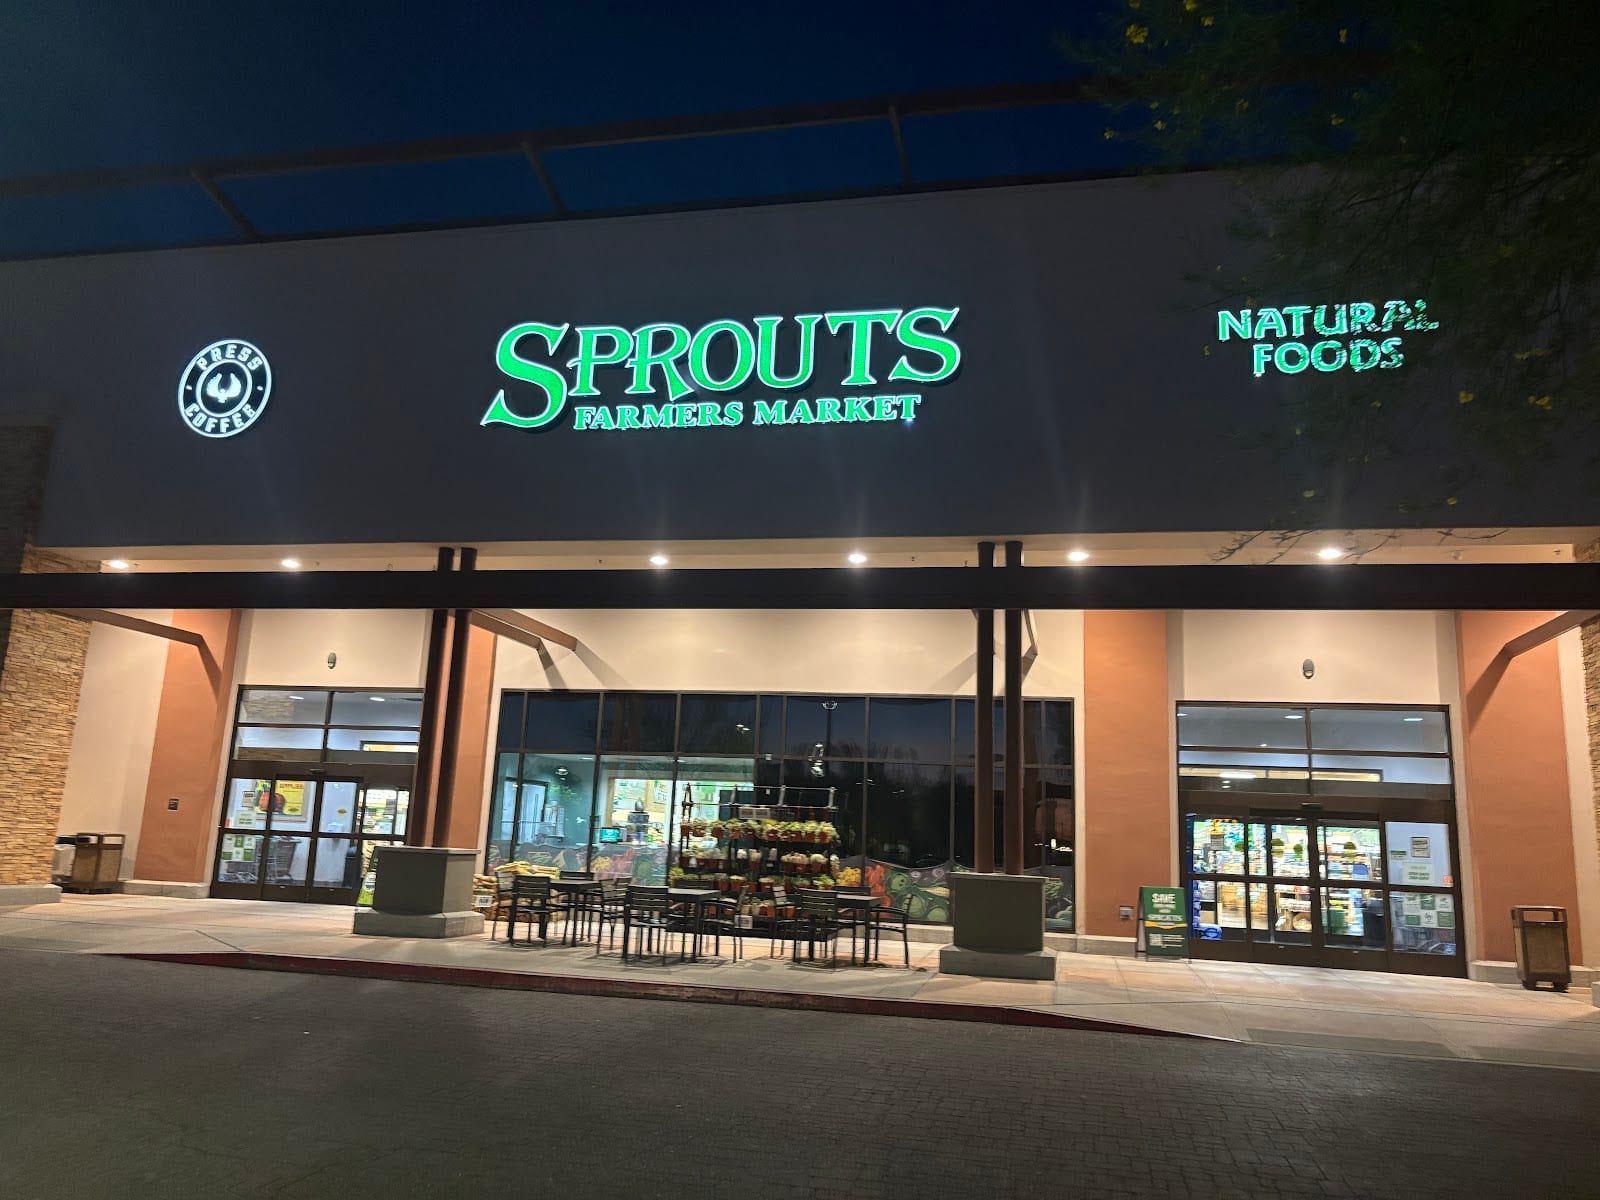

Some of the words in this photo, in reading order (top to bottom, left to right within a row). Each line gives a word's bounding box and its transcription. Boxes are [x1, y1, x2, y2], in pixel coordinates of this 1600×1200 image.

[1217, 299, 1440, 342] NATURAL
[196, 343, 263, 371] PRESS
[480, 307, 961, 428] SPROUTS
[1252, 336, 1405, 378] FOODS
[184, 402, 256, 433] COFFEE
[572, 400, 744, 431] FARMERS
[752, 393, 923, 425] MARKET
